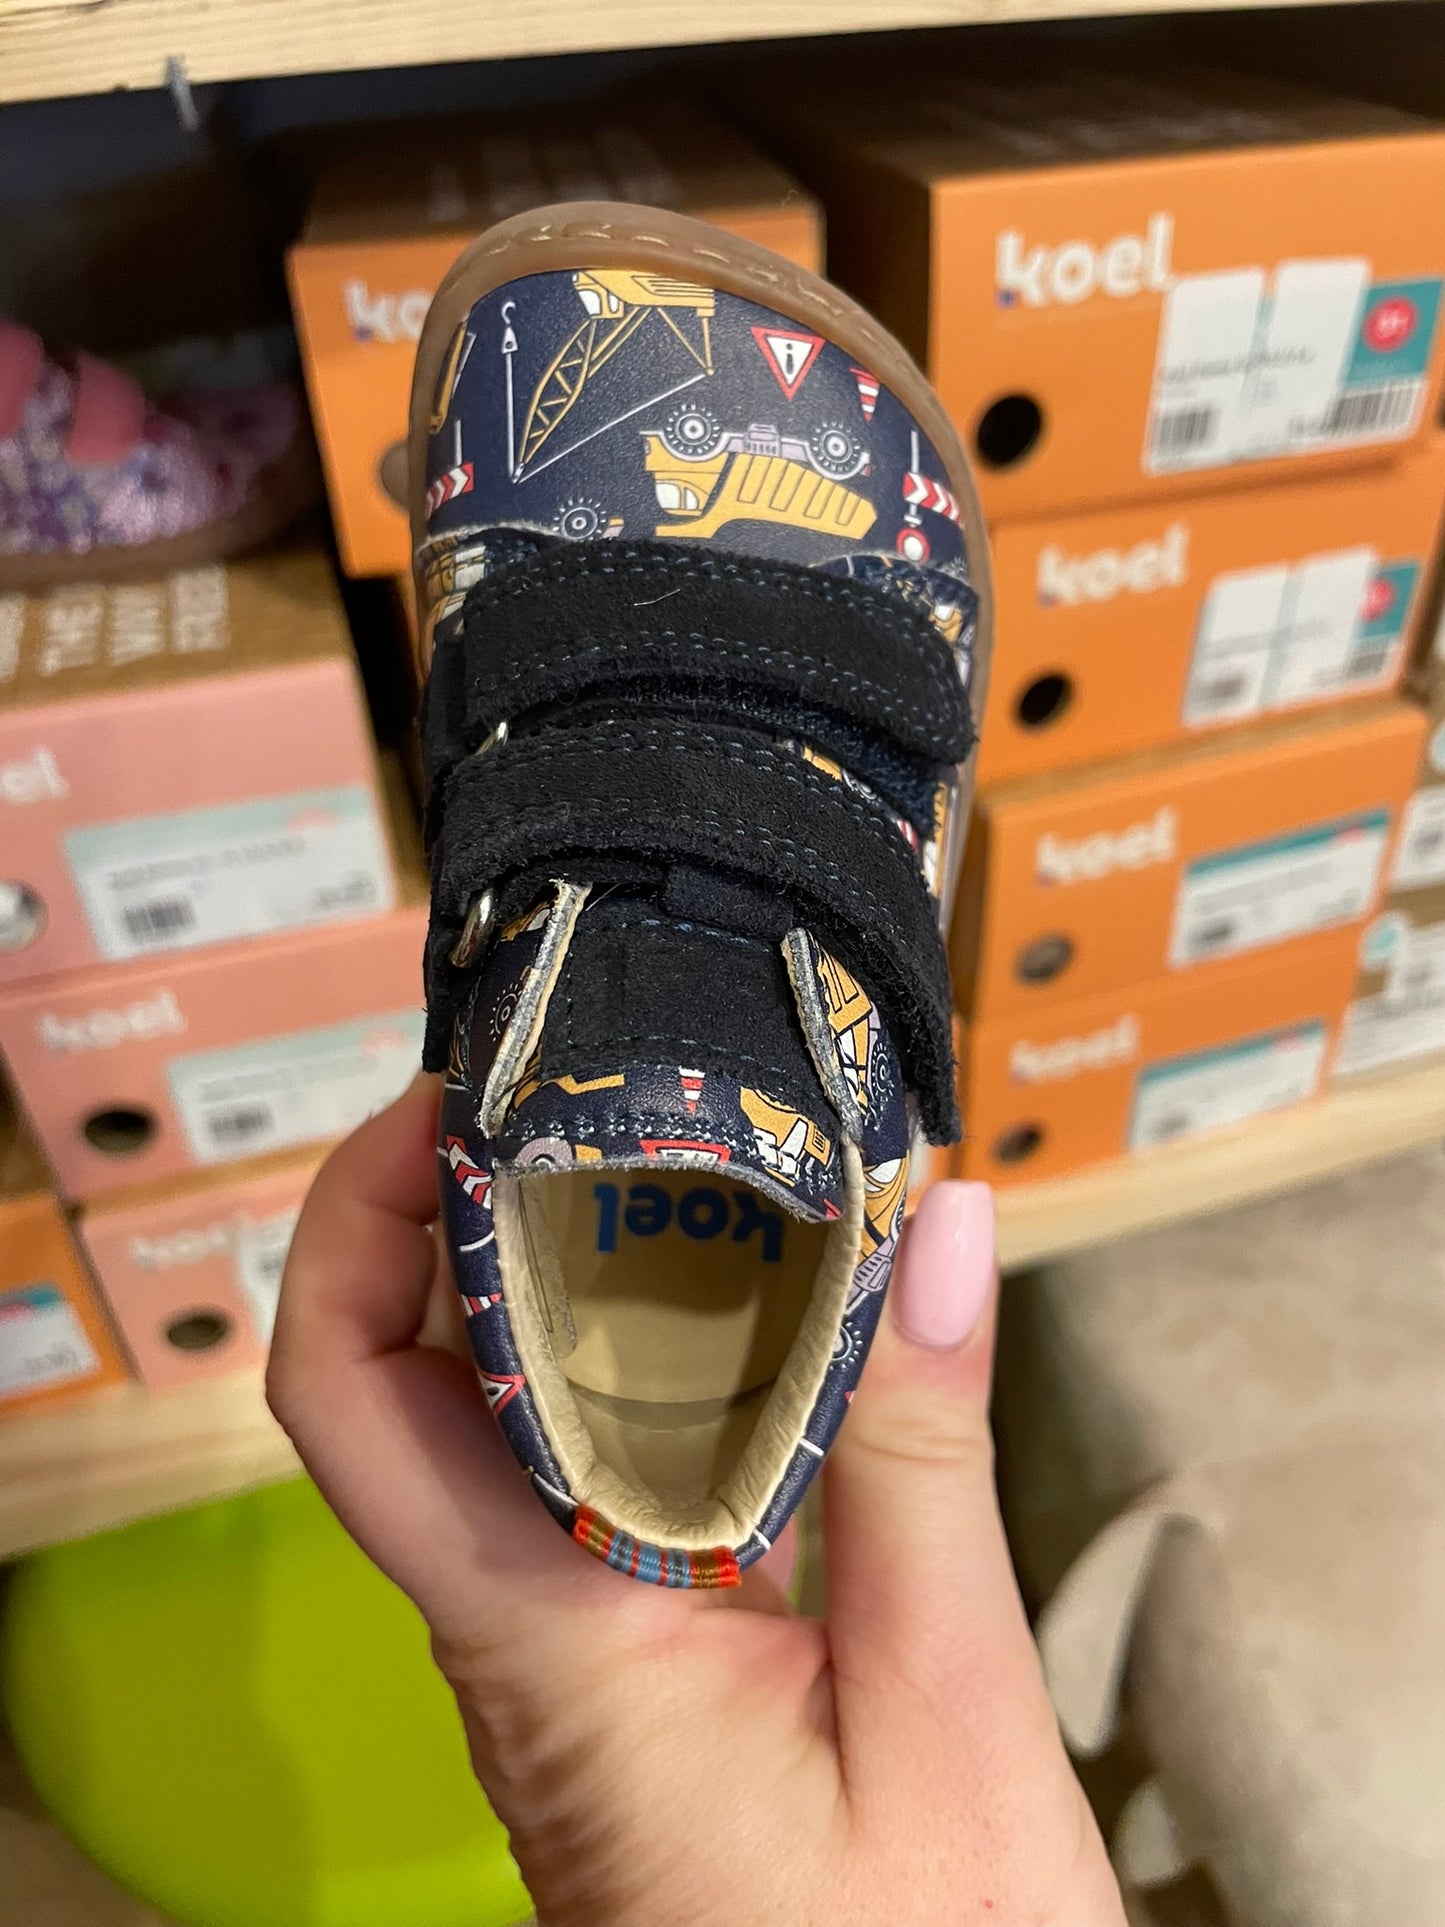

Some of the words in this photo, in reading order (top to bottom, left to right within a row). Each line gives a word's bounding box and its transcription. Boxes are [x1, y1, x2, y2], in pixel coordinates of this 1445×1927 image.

[997, 212, 1173, 306] koel
[1036, 523, 1189, 607] koel
[592, 1182, 785, 1263] koel
